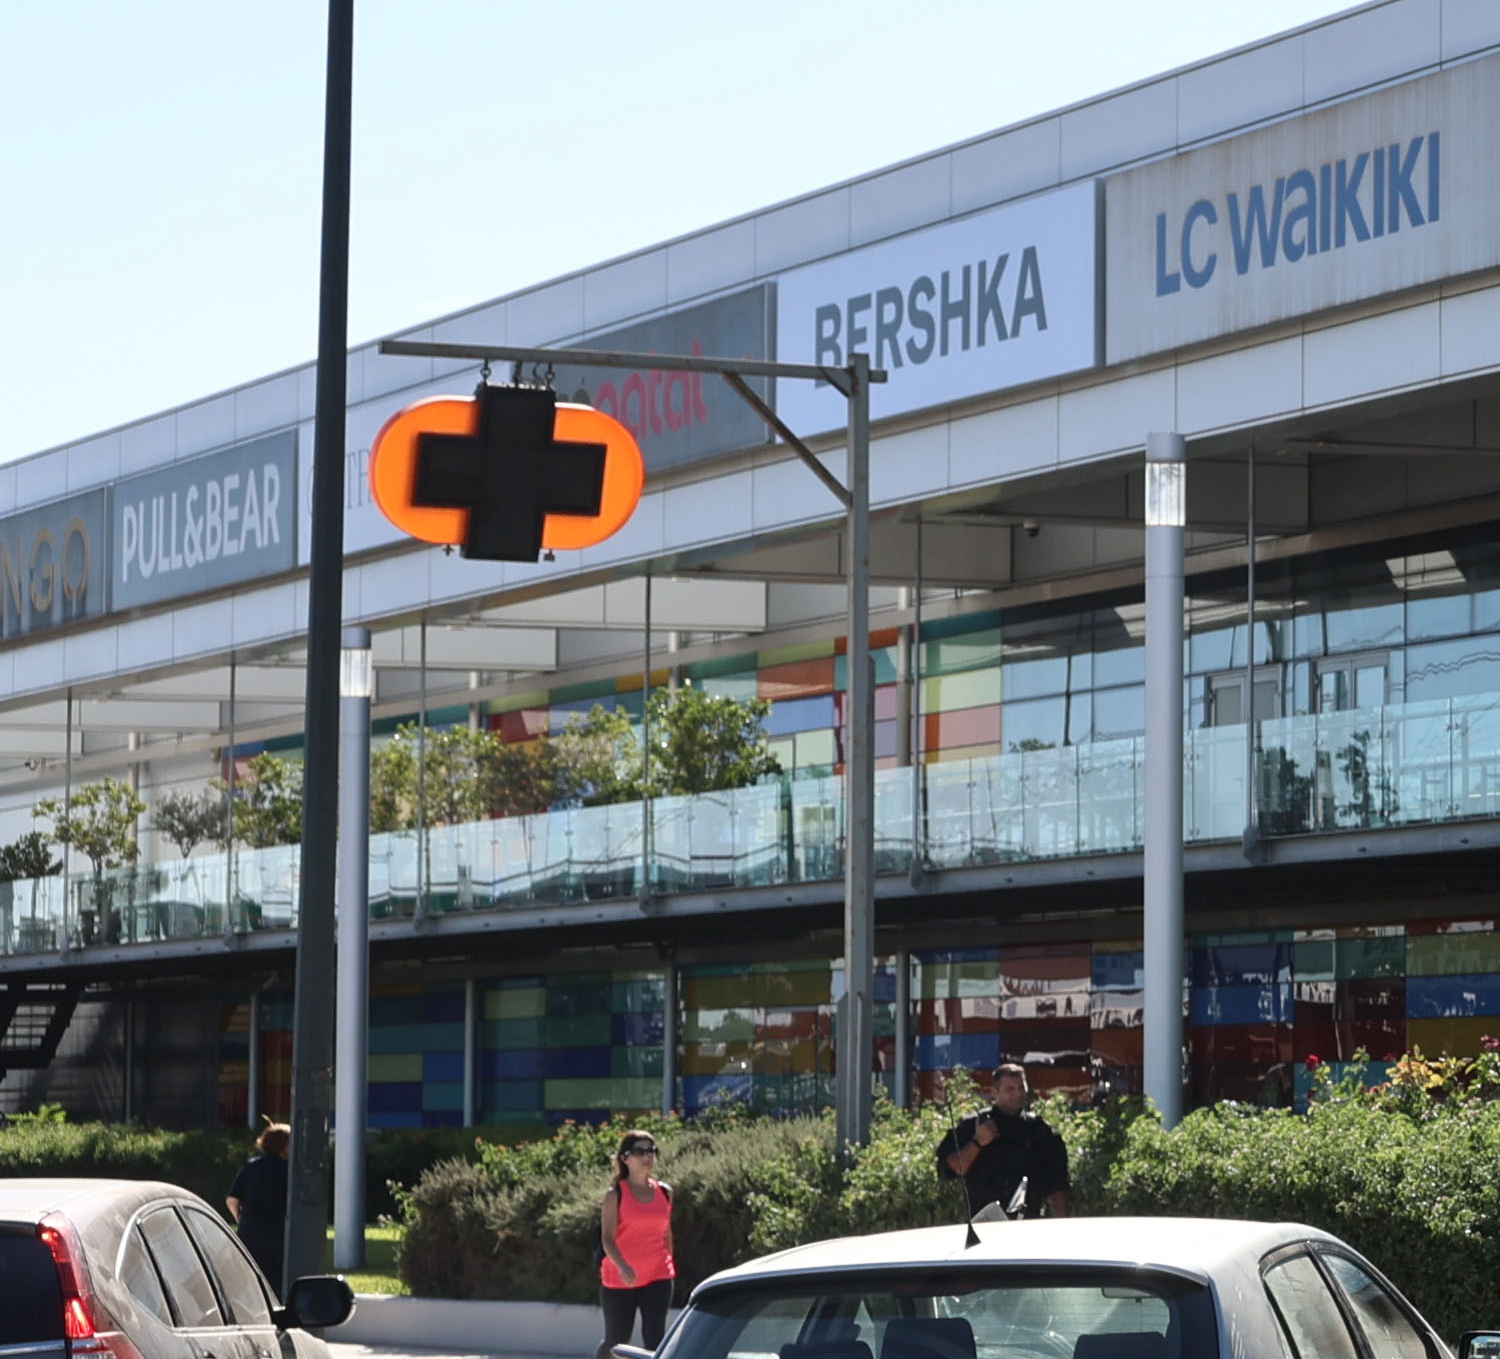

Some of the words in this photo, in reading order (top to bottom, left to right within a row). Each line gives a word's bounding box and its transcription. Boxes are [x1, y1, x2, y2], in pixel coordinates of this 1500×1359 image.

[1155, 200, 1218, 298] LC
[814, 245, 1049, 389] BERSHKA
[122, 463, 281, 583] PULL&BEAR
